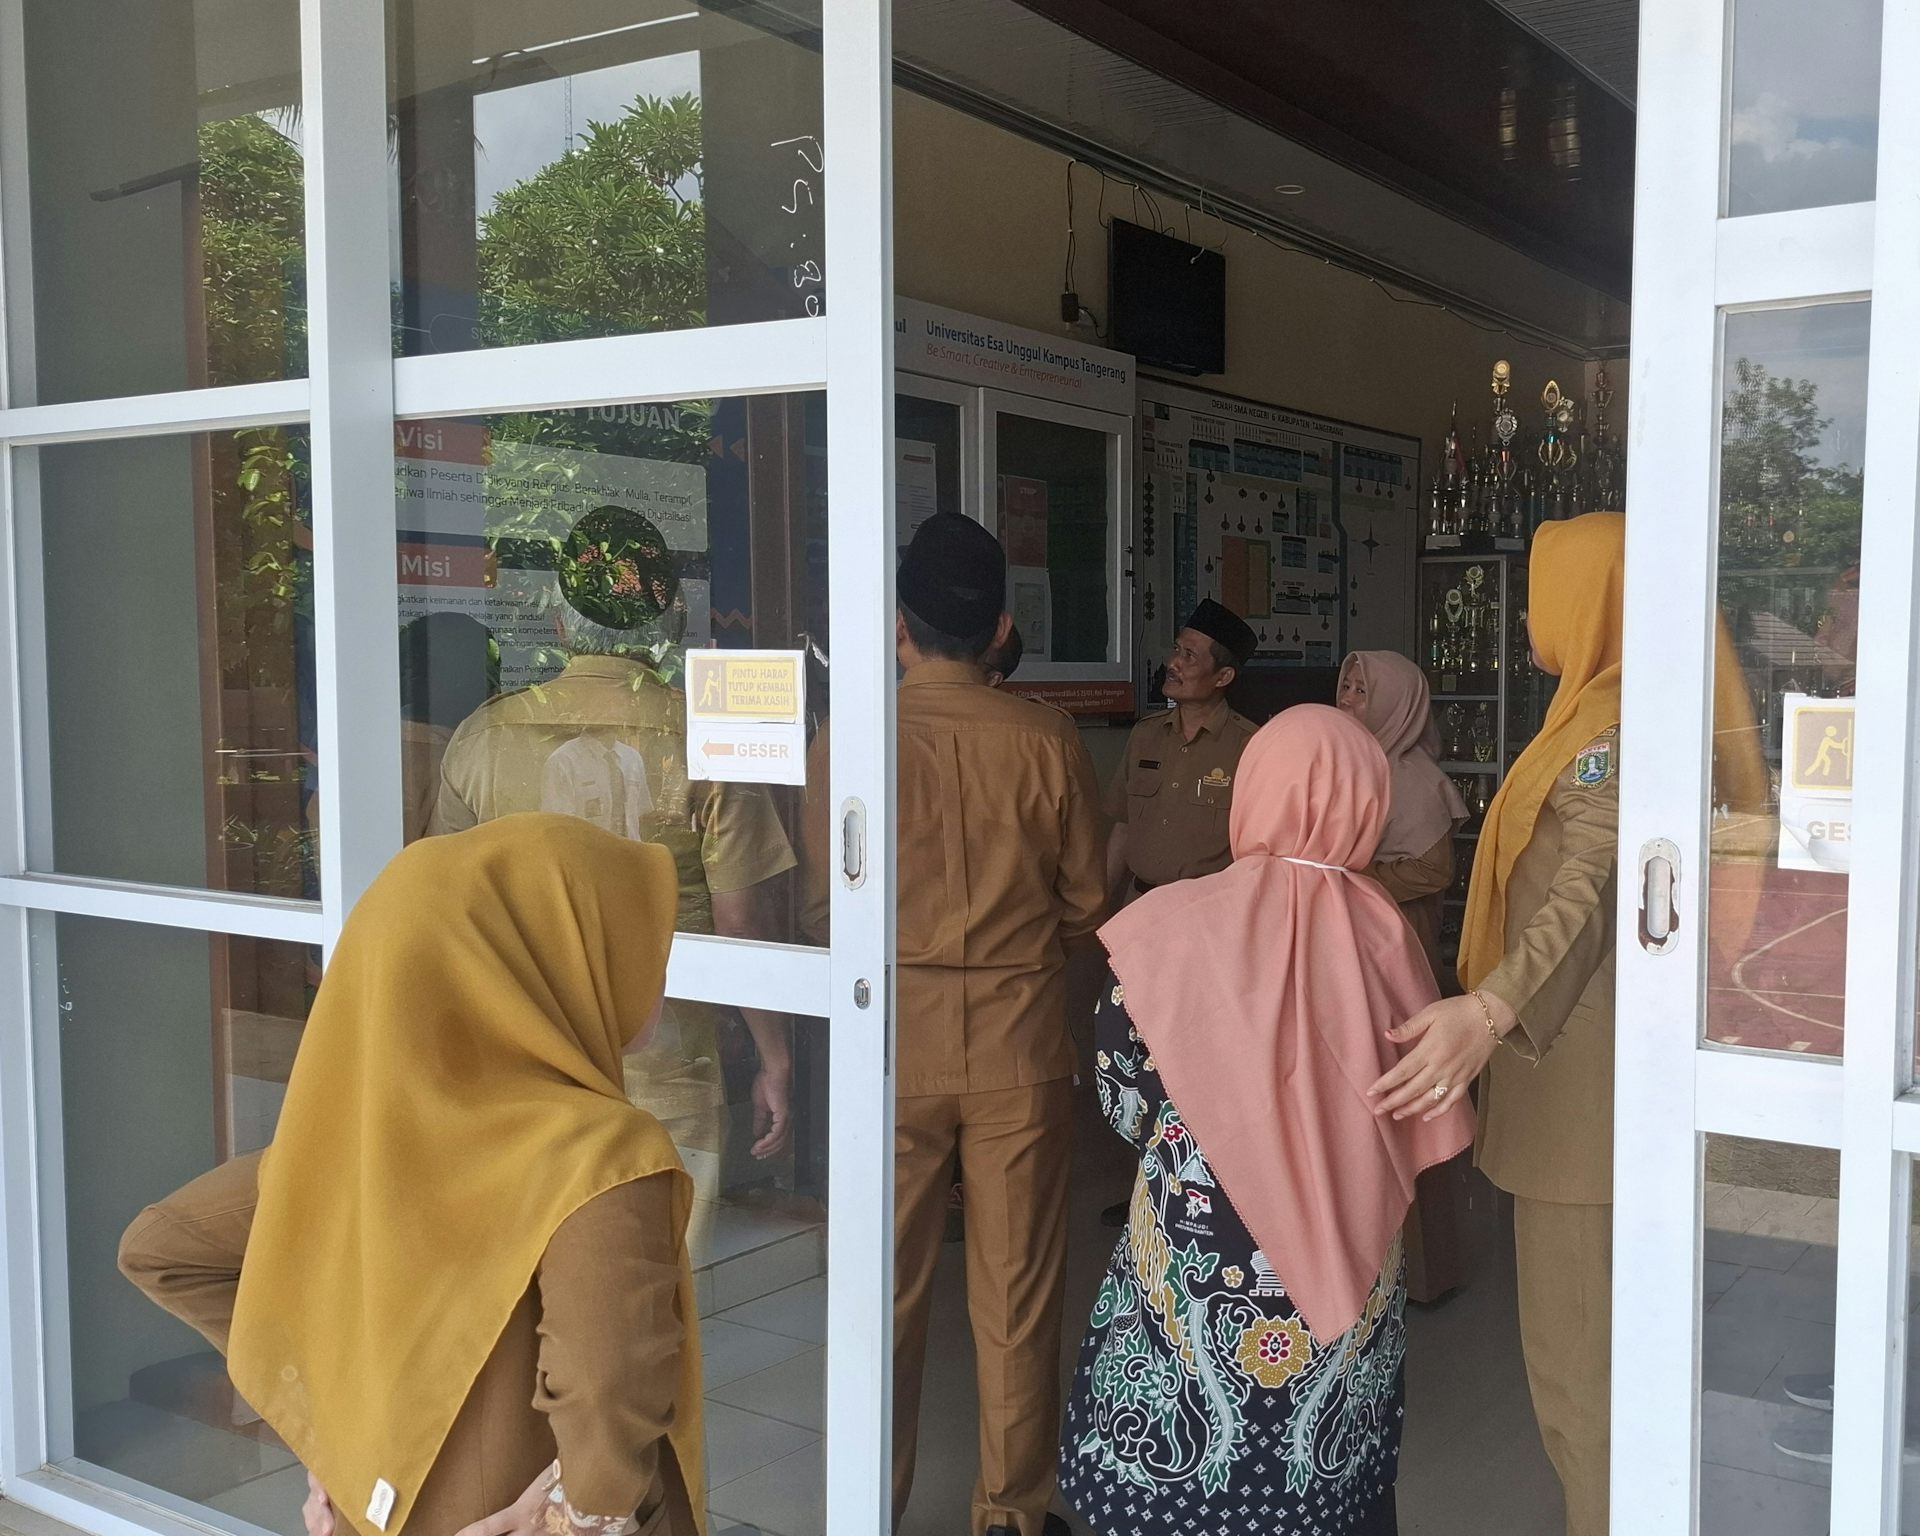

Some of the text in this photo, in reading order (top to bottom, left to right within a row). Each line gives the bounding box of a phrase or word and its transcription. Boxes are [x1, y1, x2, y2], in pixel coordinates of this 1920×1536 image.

[926, 320, 1126, 384] Universitas Esa Unggul Kampus Tangerang
[927, 342, 939, 357] Be
[973, 353, 1010, 373] Creative
[1211, 399, 1233, 412] DENAH
[1233, 404, 1248, 416] SMA
[1248, 408, 1270, 420] NEGERI
[396, 424, 443, 451] Visi
[401, 553, 451, 578] Misi
[732, 668, 788, 679] PINTU HARAP
[729, 681, 793, 692] TUTUP KEMBALI
[732, 695, 790, 706] TERIMA KASIH
[737, 743, 789, 759] GESER
[1807, 821, 1852, 842] GE
